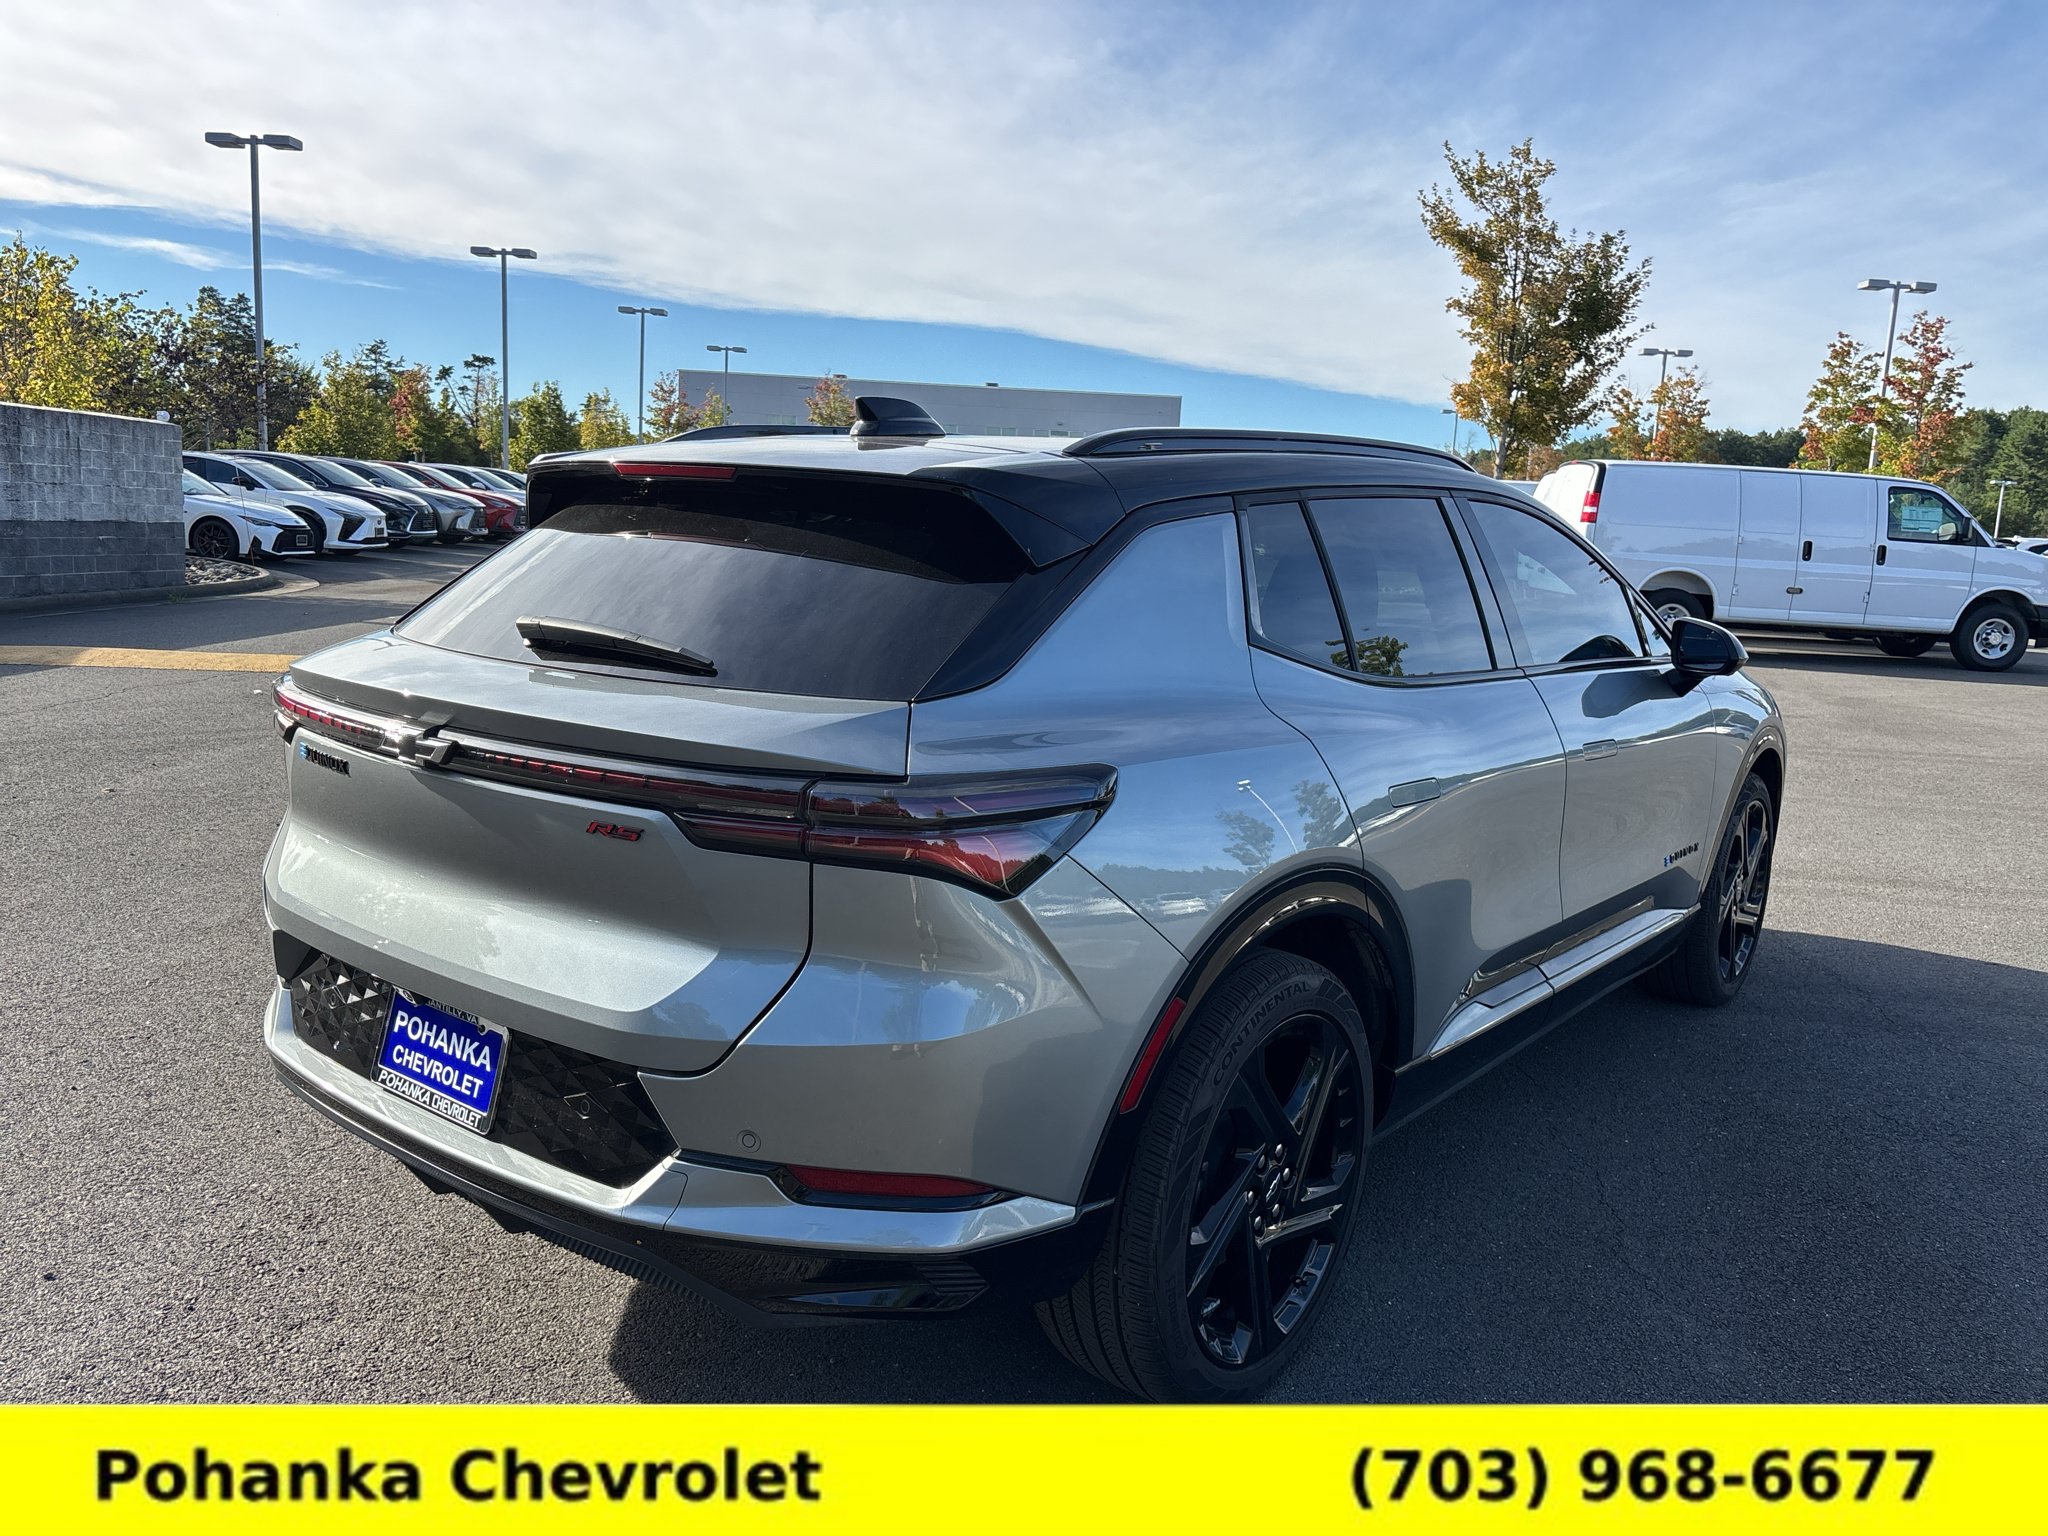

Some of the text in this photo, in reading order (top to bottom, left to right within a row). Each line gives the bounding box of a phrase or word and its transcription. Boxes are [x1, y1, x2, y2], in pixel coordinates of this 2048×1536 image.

[586, 820, 645, 842] RS
[393, 1010, 492, 1072] POHANKA
[1213, 981, 1310, 1086] CONTINENTAL
[377, 1070, 482, 1128] POHANKA CHEVROLET
[392, 1044, 484, 1099] CHEVROLET
